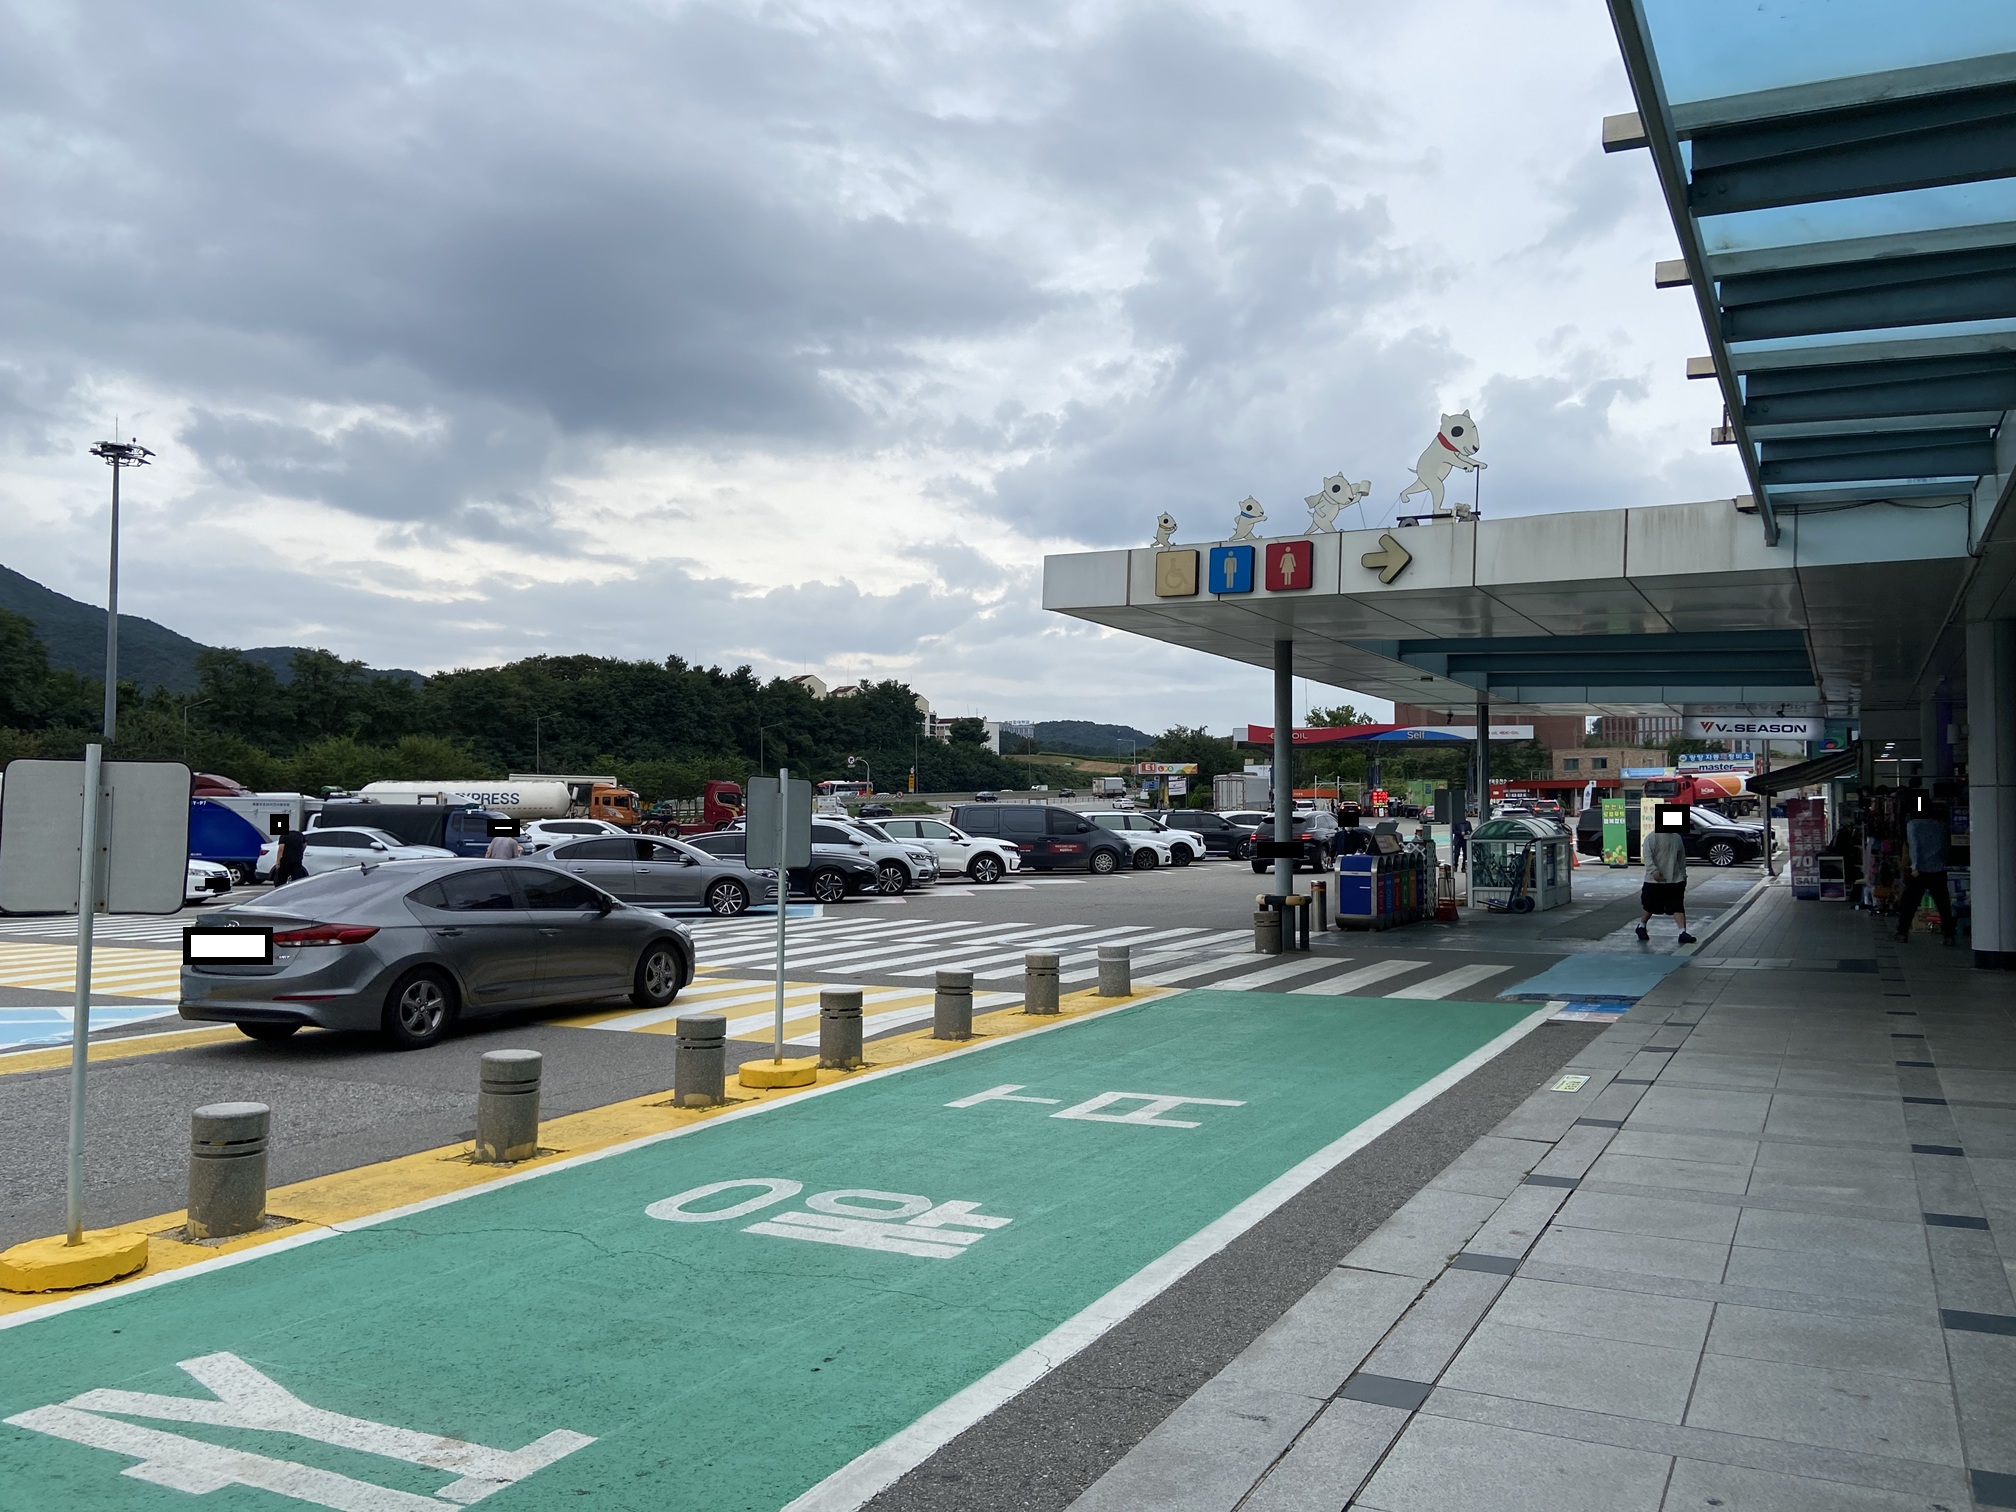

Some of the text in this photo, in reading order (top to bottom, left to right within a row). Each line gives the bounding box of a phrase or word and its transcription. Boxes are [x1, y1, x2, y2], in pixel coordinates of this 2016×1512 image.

[1407, 731, 1425, 740] Self
[1792, 855, 1813, 868] 70
[1795, 877, 1819, 885] SAL
